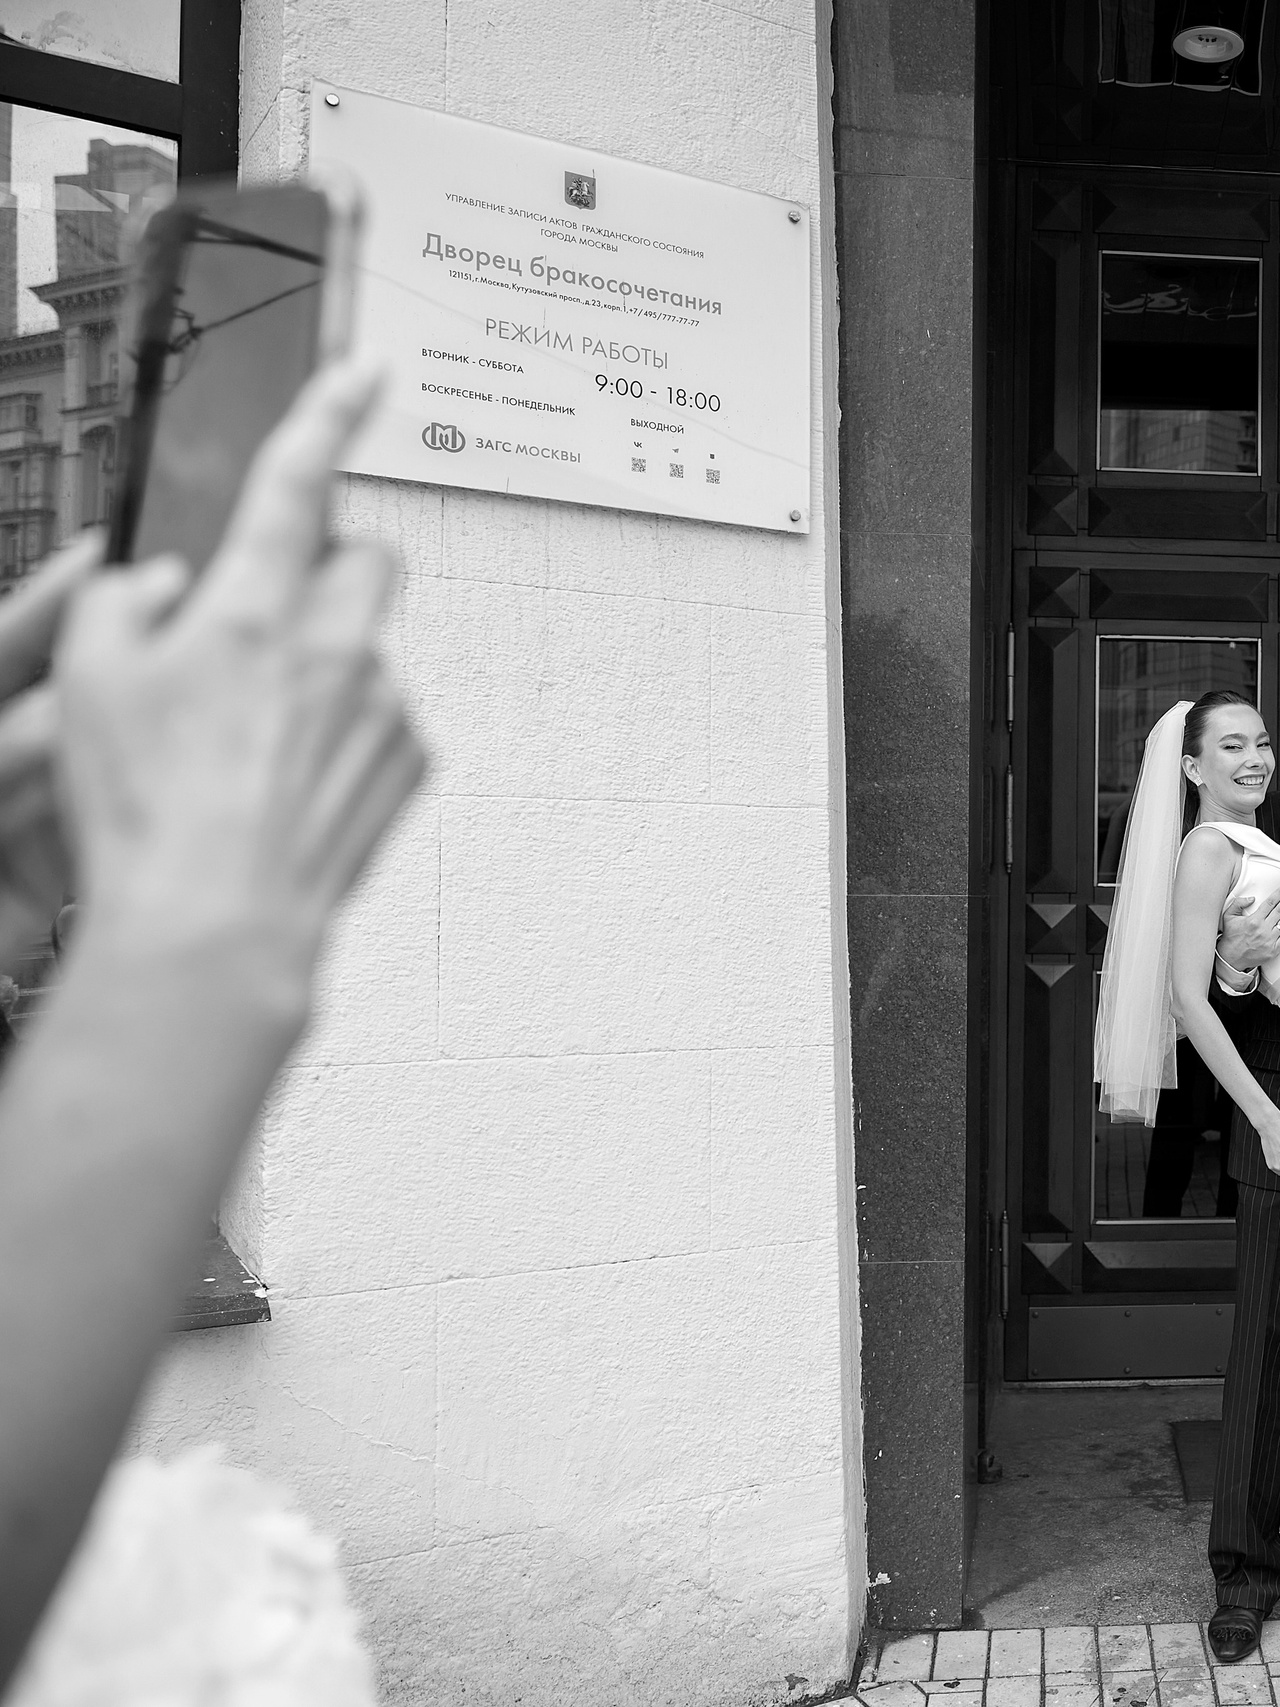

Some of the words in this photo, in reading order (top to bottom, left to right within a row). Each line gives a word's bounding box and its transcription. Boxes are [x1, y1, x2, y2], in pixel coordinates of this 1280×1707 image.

[445, 193, 505, 213] УПРАВЛЕНИЕ
[507, 207, 547, 222] ЗАПИСИ
[549, 217, 577, 230] АКТОВ
[581, 224, 651, 246] ГРАЖДАНСКОГО
[652, 241, 704, 258] СОСТОЯНИЯ
[540, 228, 577, 243] ГОРОДА
[579, 238, 618, 252] МОСКВЫ
[422, 232, 522, 277] Дворец
[530, 255, 722, 315] бракосочетания
[421, 348, 469, 364] ВТОРНИК
[478, 358, 524, 373] СУББОТА
[485, 318, 573, 351] РЕЖИМ
[582, 336, 668, 369] РАБОТЫ
[421, 382, 493, 402] ВОСКРЕСЕНЬЕ
[501, 396, 576, 416] ПОНЕДЕЛЬНИК
[595, 374, 643, 398] 9:00
[667, 386, 721, 412] 18:00
[630, 418, 685, 434] ВЫХОДНОЙ
[475, 437, 512, 453] ЗАГС
[515, 443, 581, 463] МОСКВЫ
